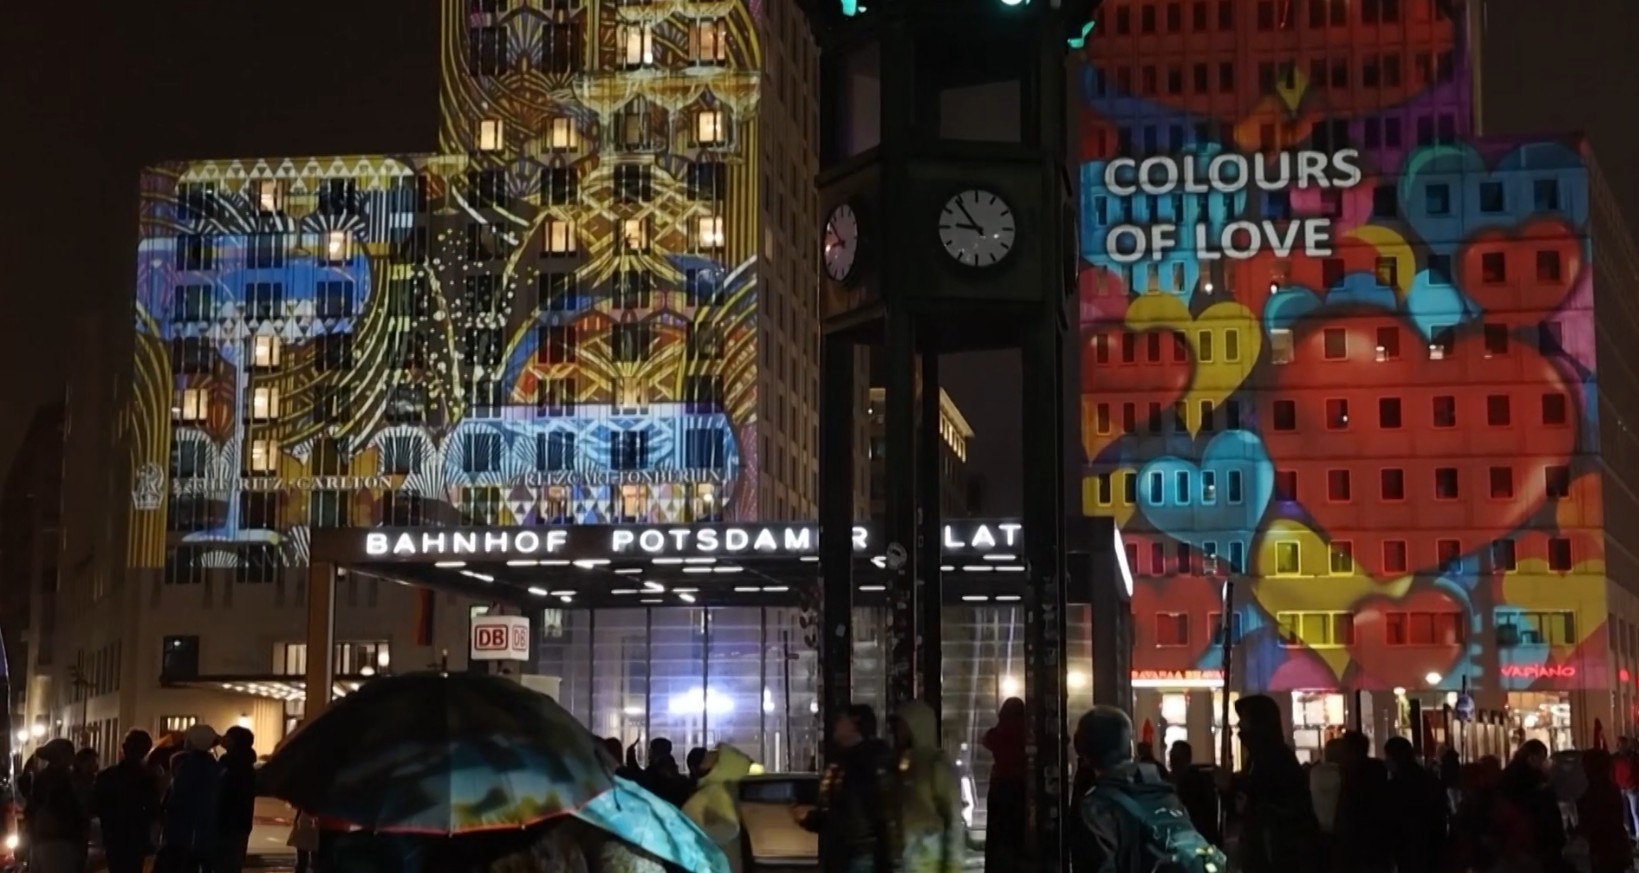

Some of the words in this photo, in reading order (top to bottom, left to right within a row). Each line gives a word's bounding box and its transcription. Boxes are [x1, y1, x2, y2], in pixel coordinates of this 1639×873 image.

[1104, 148, 1362, 196] COLOURS
[1106, 224, 1177, 262] OF
[1196, 217, 1332, 260] LOVE
[366, 530, 568, 554] BAHNHOF
[612, 527, 869, 552] POTSDAMR
[943, 524, 1022, 548] LAT
[479, 629, 504, 646] DB
[514, 629, 526, 647] DB
